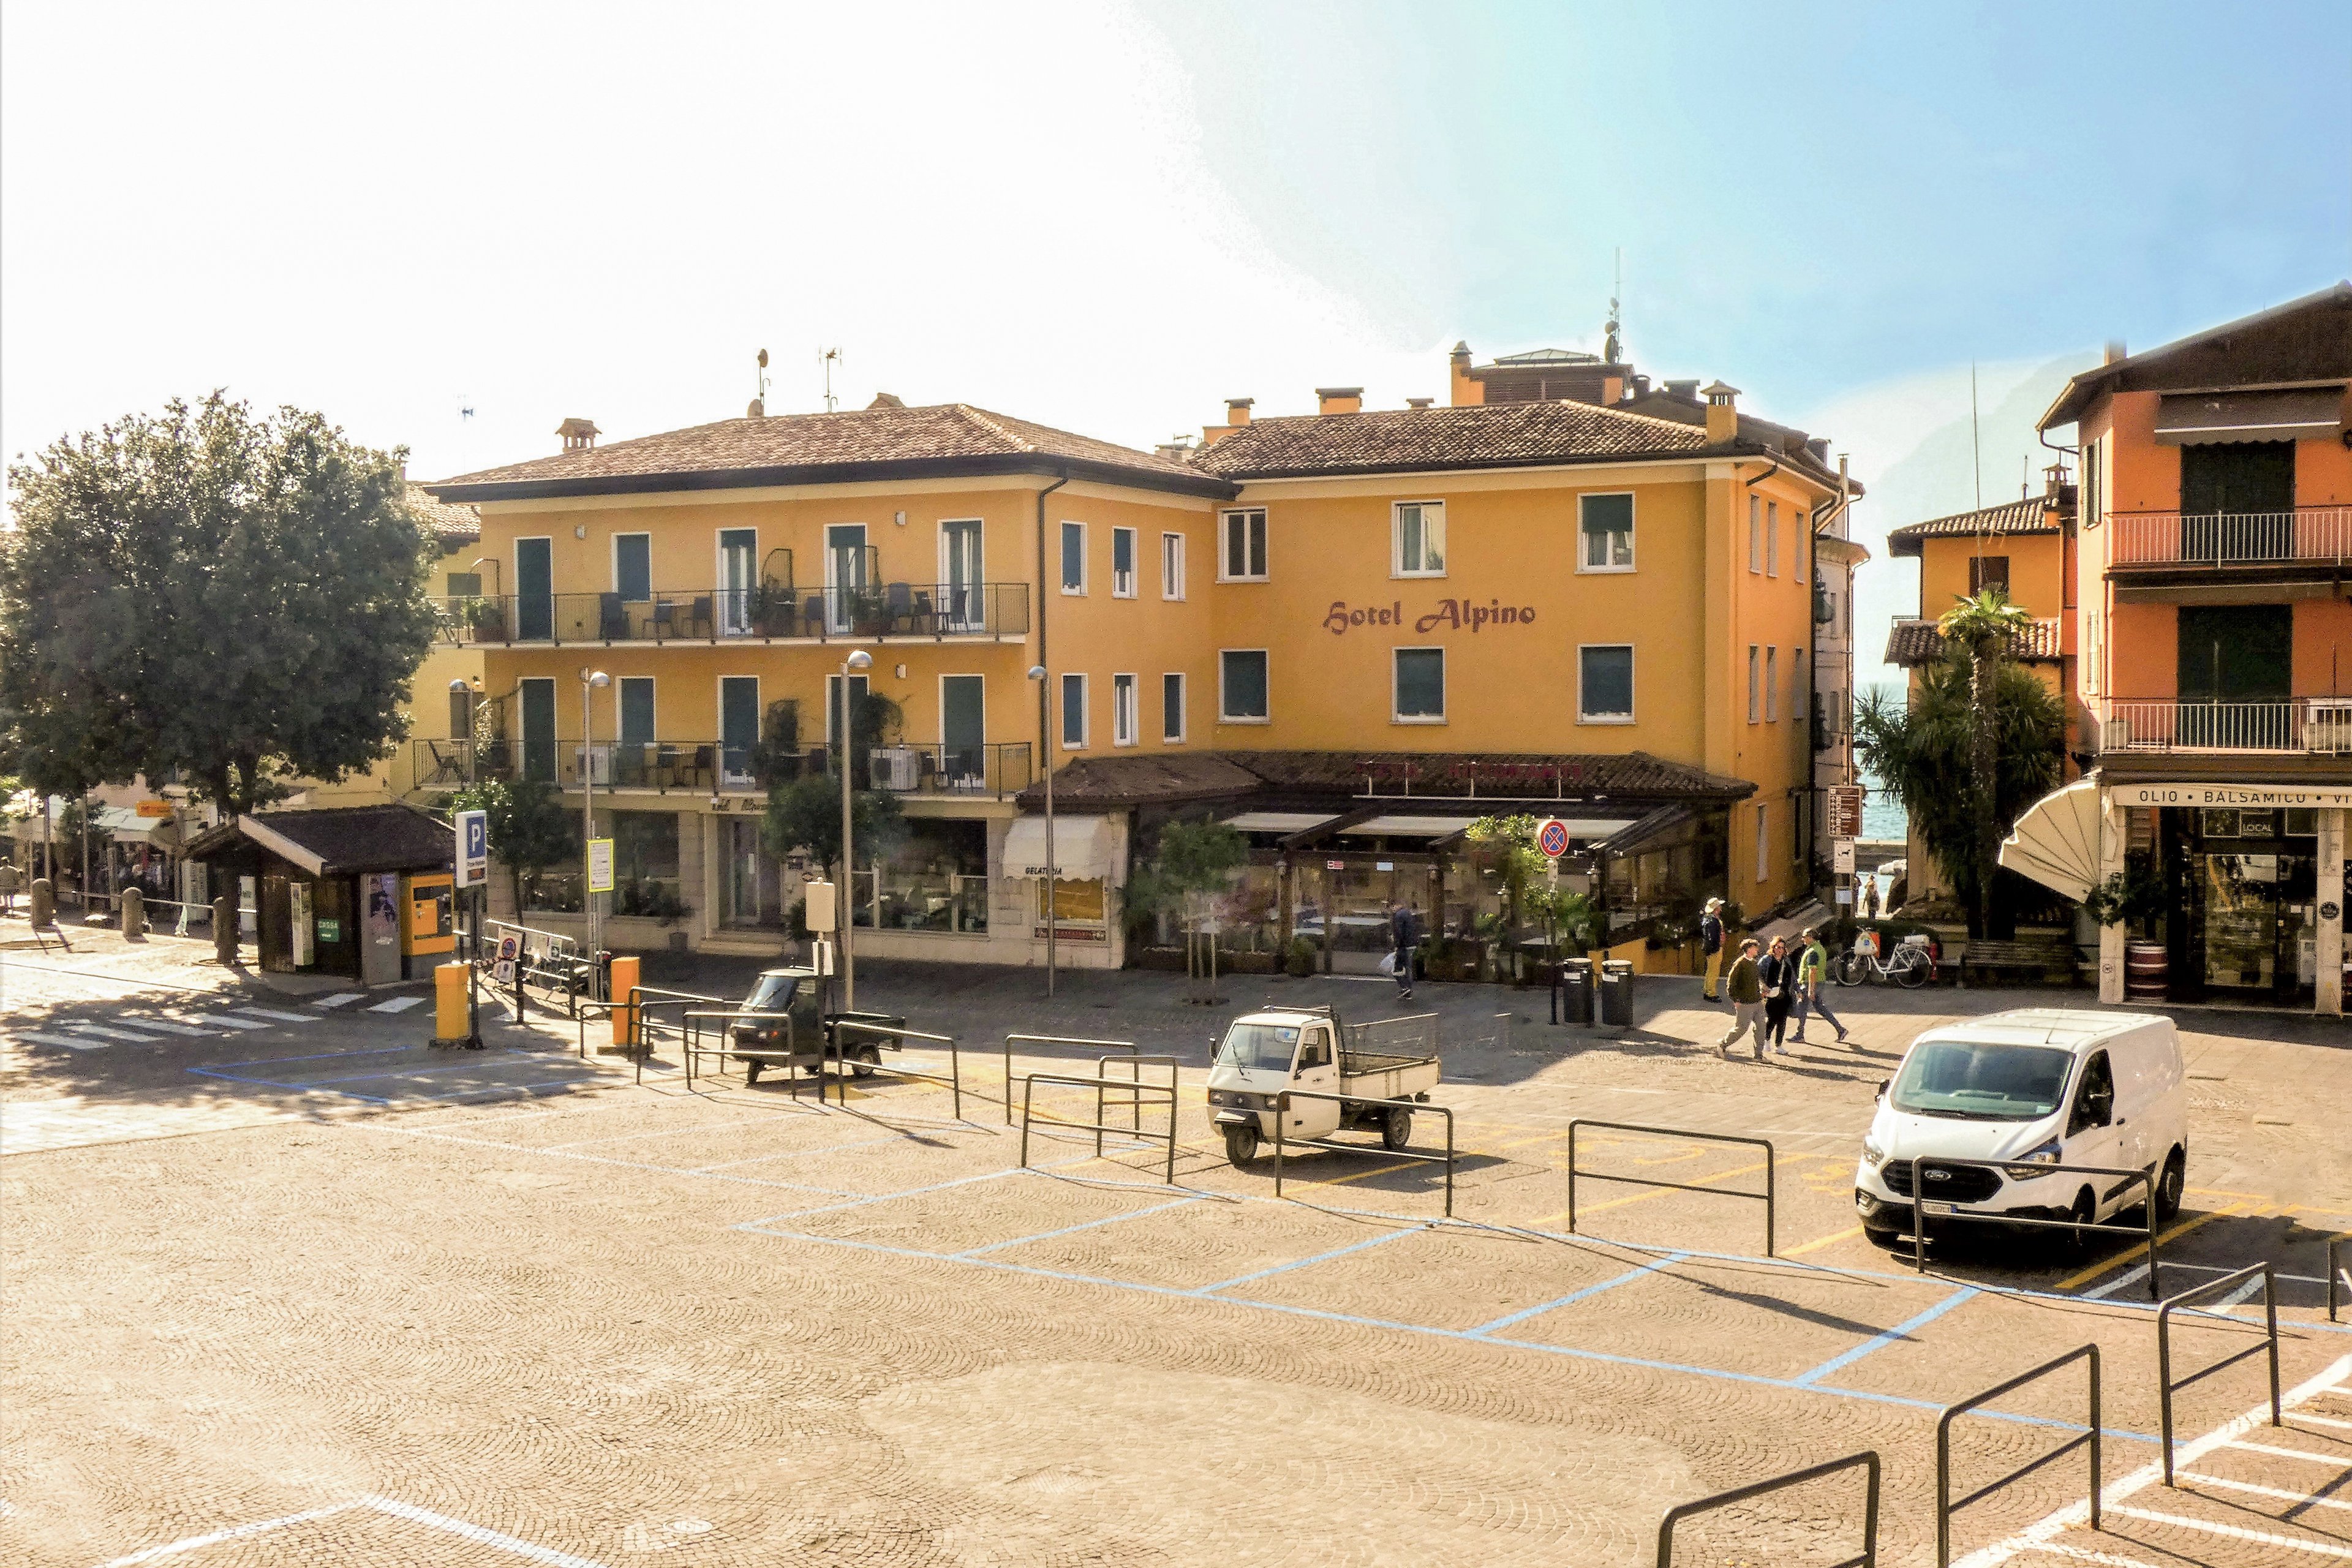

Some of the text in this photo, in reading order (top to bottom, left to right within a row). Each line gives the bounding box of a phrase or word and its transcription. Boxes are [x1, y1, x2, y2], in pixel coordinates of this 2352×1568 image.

[1322, 598, 1536, 635] Hotel Alpino
[2139, 790, 2177, 802] OLIO
[2204, 791, 2305, 803] BALSAMICO
[471, 823, 481, 852] P
[2243, 823, 2272, 832] LOCAL
